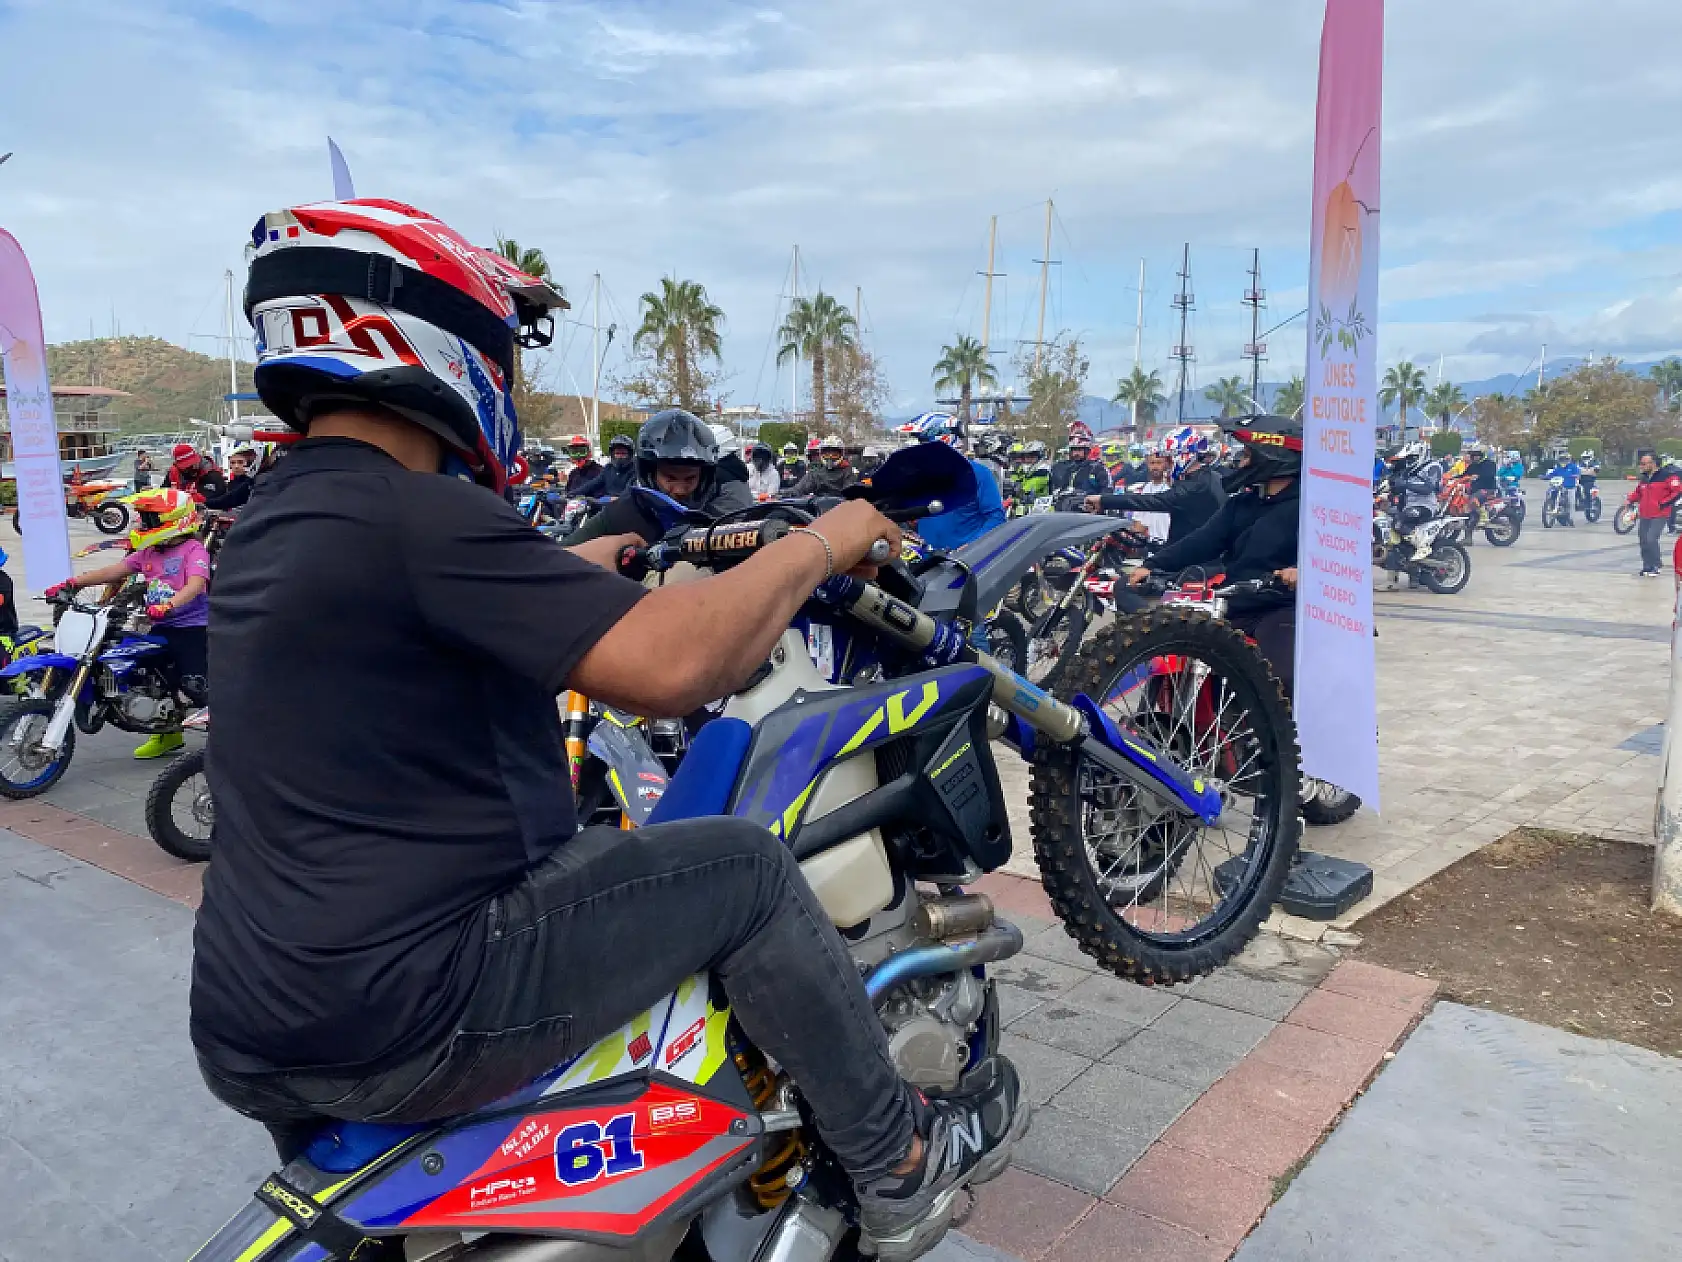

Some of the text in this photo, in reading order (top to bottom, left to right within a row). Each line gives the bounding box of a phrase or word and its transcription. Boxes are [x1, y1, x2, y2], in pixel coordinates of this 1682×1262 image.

[1320, 428, 1355, 455] HOTEL
[651, 1102, 697, 1121] BS
[554, 1112, 645, 1187] 61
